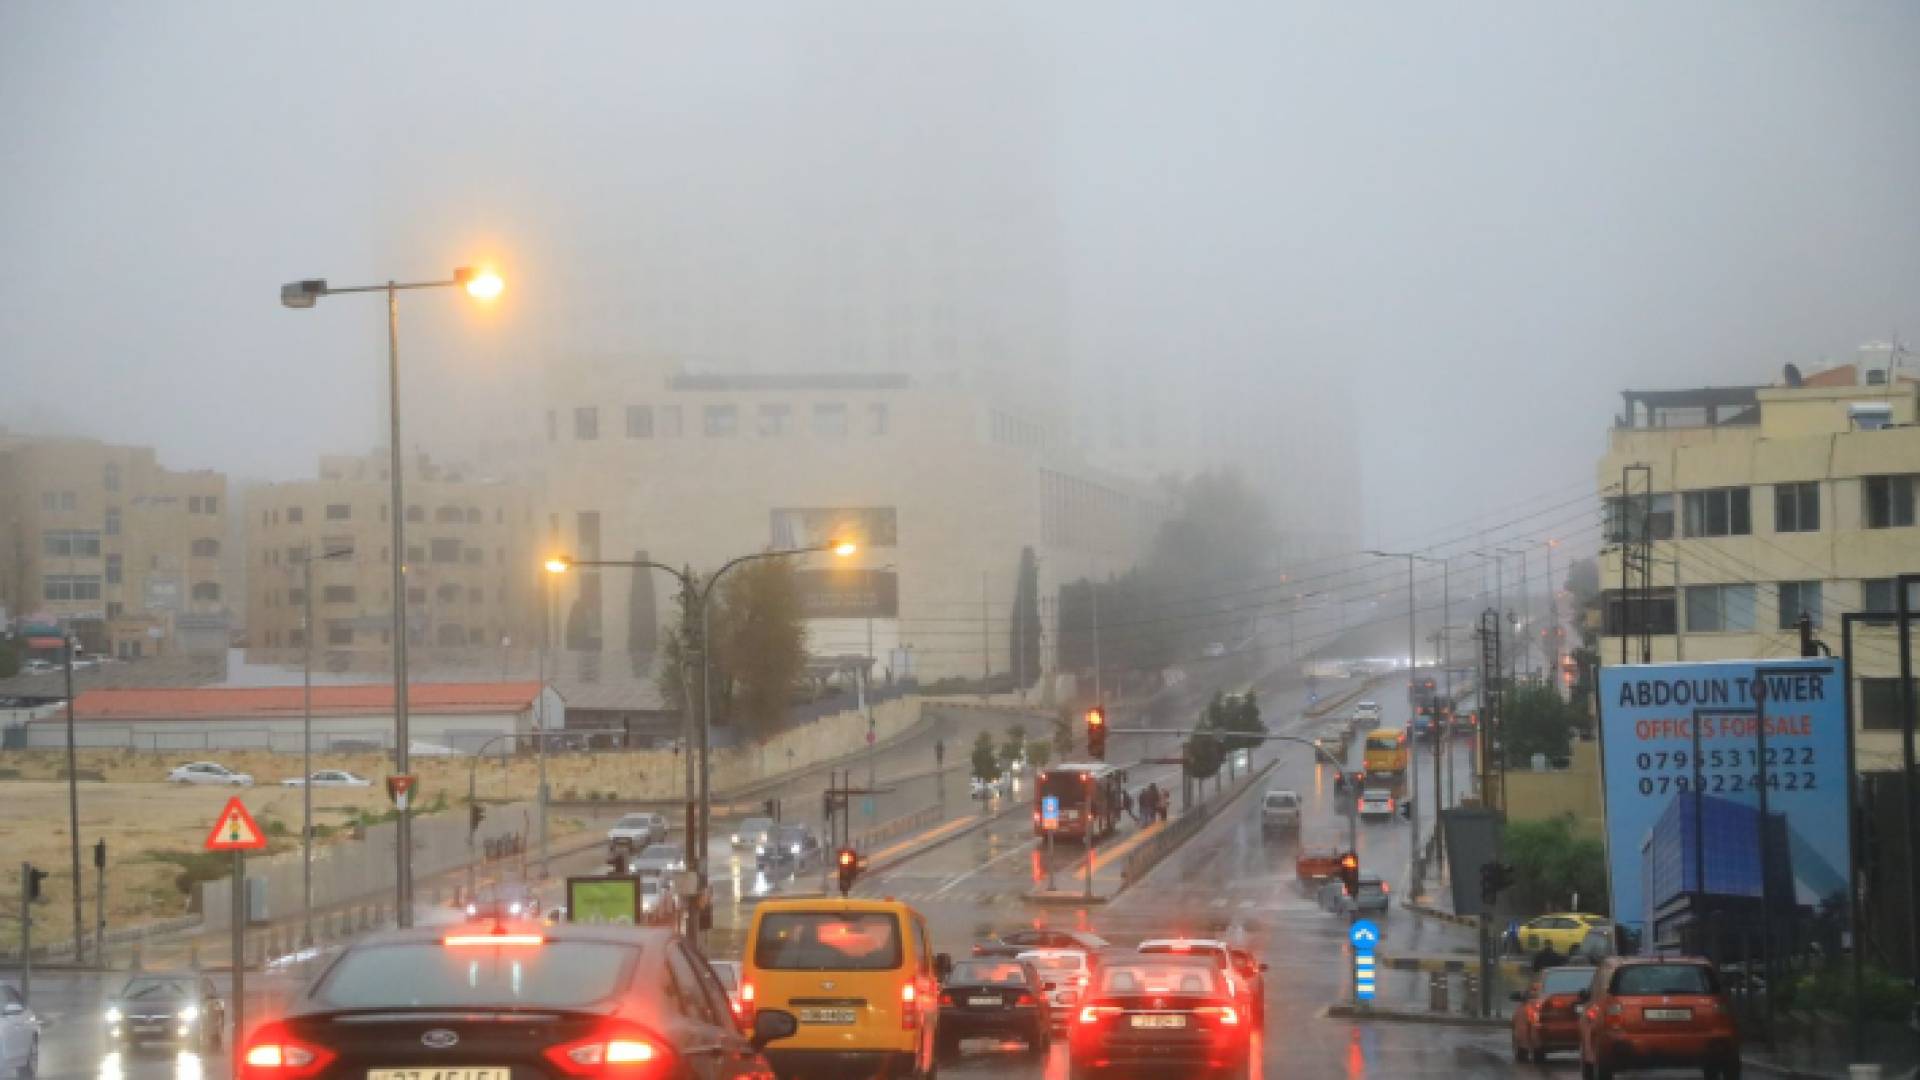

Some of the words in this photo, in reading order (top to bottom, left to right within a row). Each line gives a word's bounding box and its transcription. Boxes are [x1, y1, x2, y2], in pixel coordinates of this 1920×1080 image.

[1619, 679, 1729, 707] ABDOUN
[1735, 673, 1825, 703] TOWER
[1635, 717, 1716, 741] OFFICS
[1720, 715, 1760, 738] FOR
[1763, 714, 1813, 737] SALE
